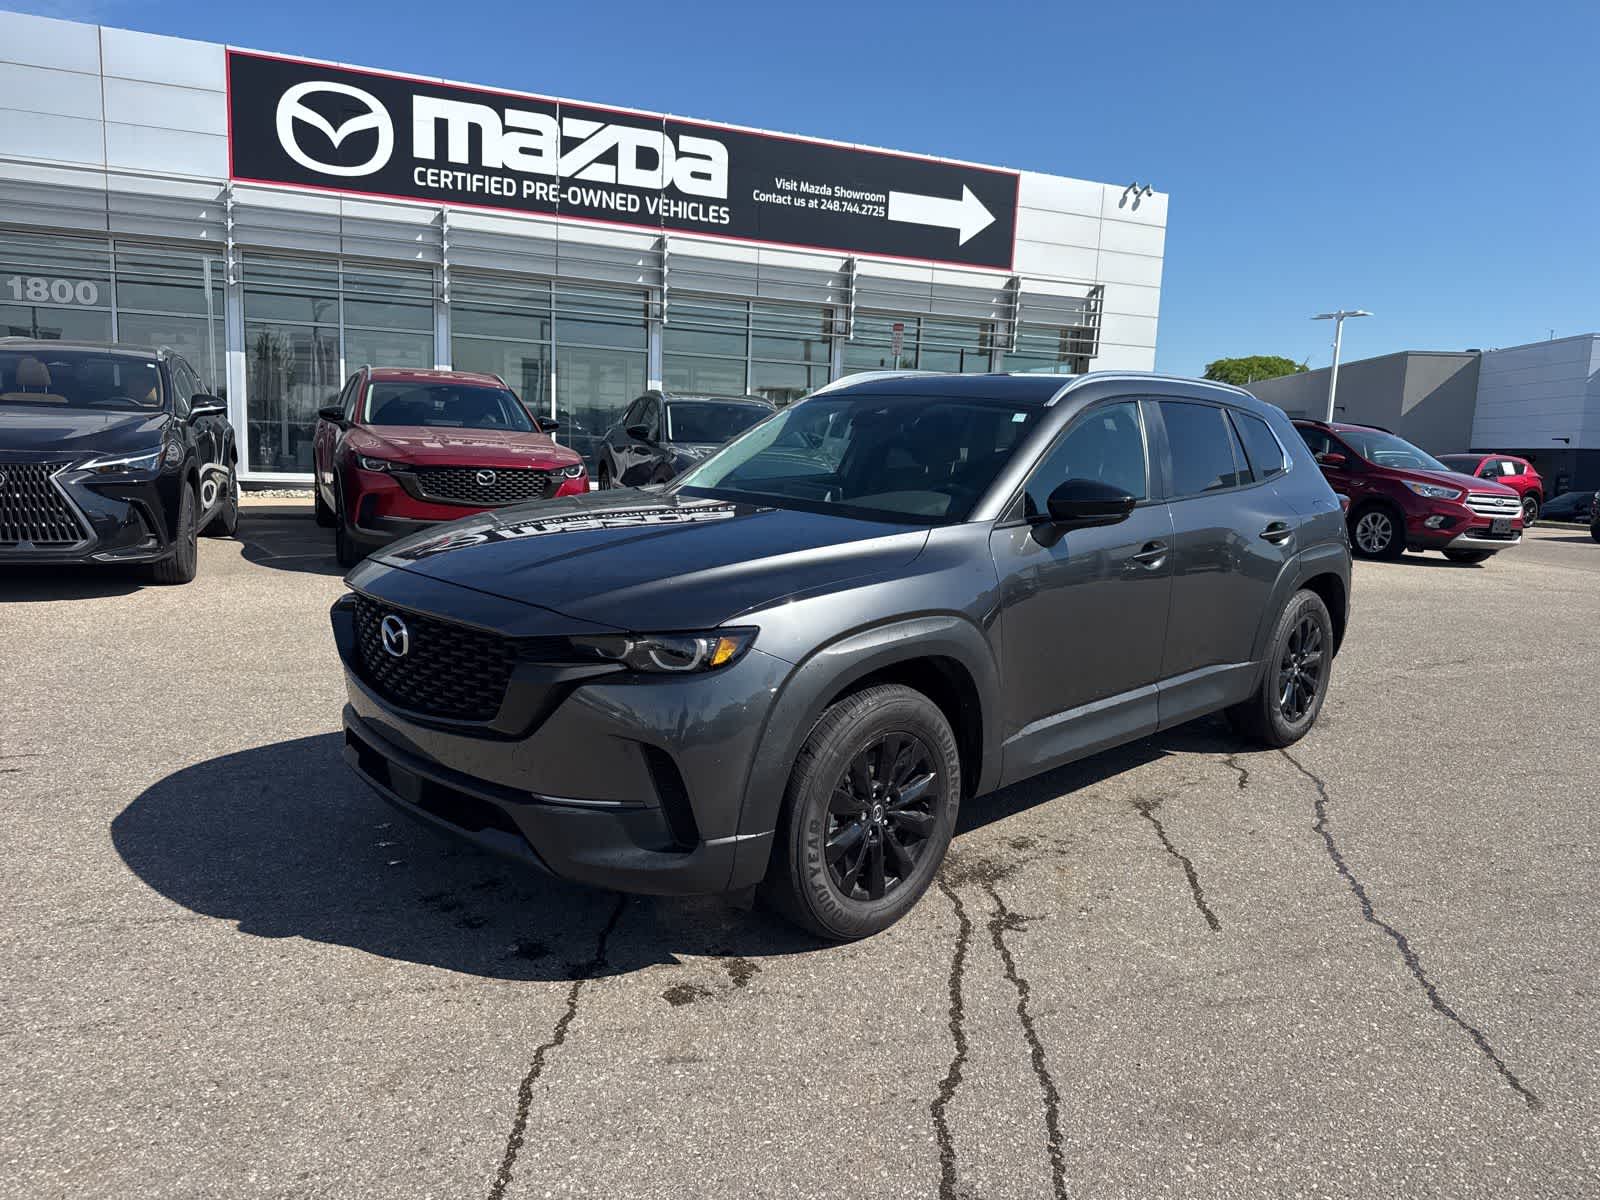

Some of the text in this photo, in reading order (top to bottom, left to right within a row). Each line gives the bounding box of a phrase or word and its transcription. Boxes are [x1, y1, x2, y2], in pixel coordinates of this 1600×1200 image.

[412, 94, 729, 200] mazda
[413, 166, 730, 225] CERTIFIED PRE-OWNED VEHICLES
[752, 189, 886, 217] Contact us at 248.744.2725
[775, 177, 886, 203] Visit Mazda Showroom
[7, 275, 98, 305] 1800
